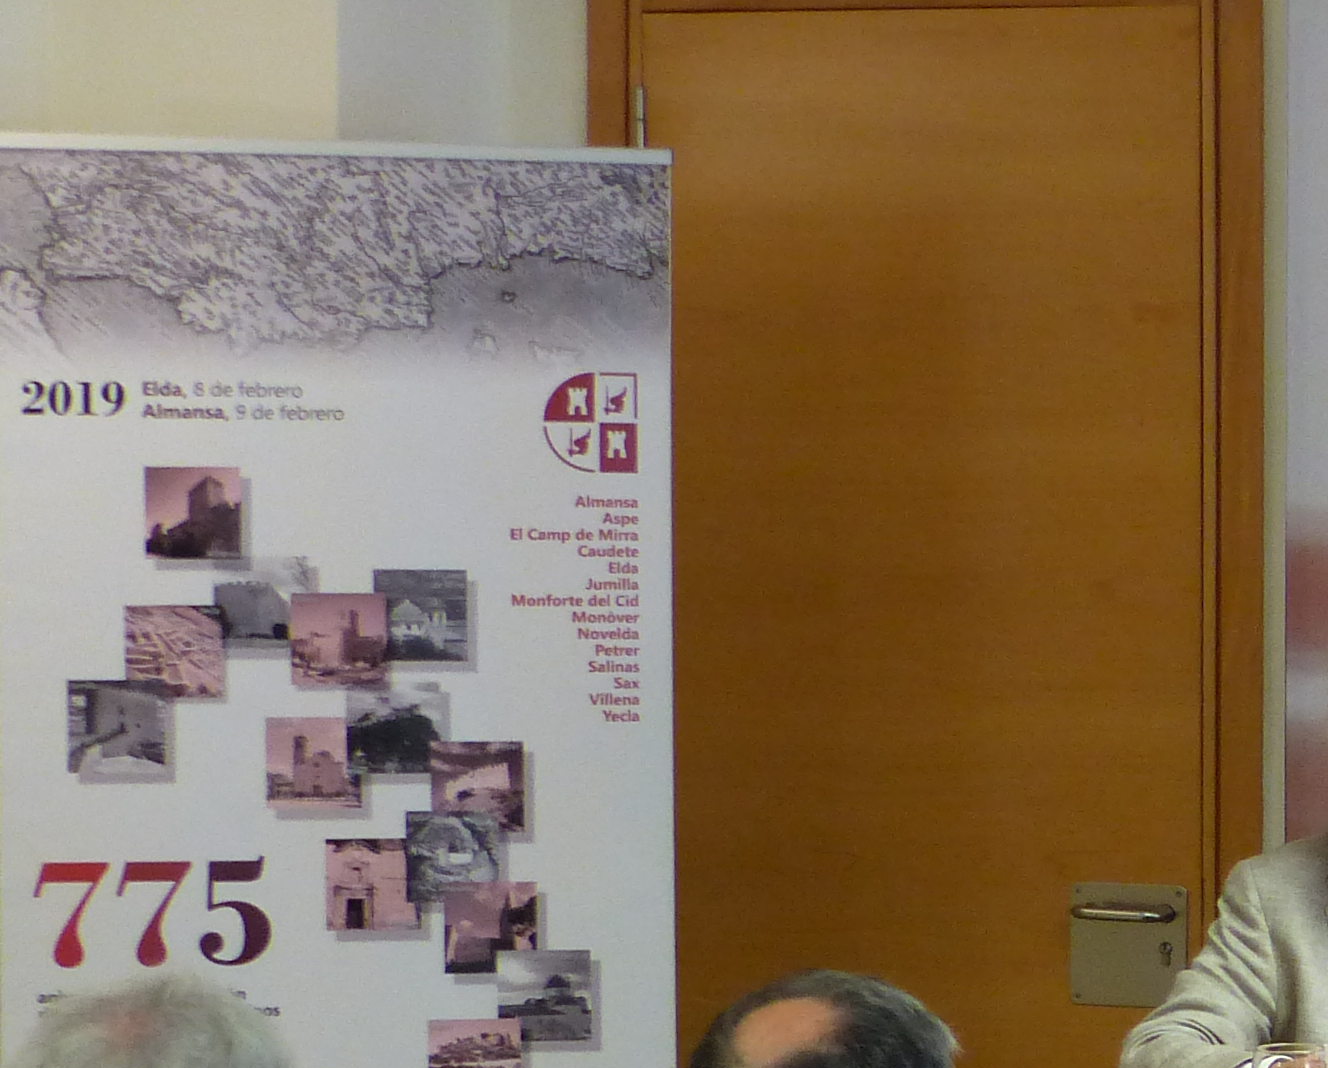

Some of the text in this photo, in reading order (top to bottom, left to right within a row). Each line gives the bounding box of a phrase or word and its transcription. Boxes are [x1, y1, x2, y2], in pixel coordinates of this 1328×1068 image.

[141, 381, 188, 400] Elda,
[210, 381, 234, 398] de
[238, 381, 304, 399] febrero
[21, 380, 127, 417] 2019
[141, 404, 346, 422] Almansa, 9 de febrero
[575, 495, 639, 509] Almansa
[602, 512, 640, 527] Aspe
[509, 528, 639, 543] El Camp de Mirra
[577, 545, 639, 558] Caudete
[608, 561, 639, 574] Elda
[585, 578, 640, 591] Jumilla
[511, 594, 640, 607] Monforte del Cid
[577, 627, 640, 640] Novelda
[595, 643, 641, 657] Petrer
[588, 660, 641, 673] Salinas
[613, 677, 640, 690] Sax
[588, 692, 641, 706] Villena
[602, 709, 641, 723] Yecla
[32, 854, 273, 968] 775
